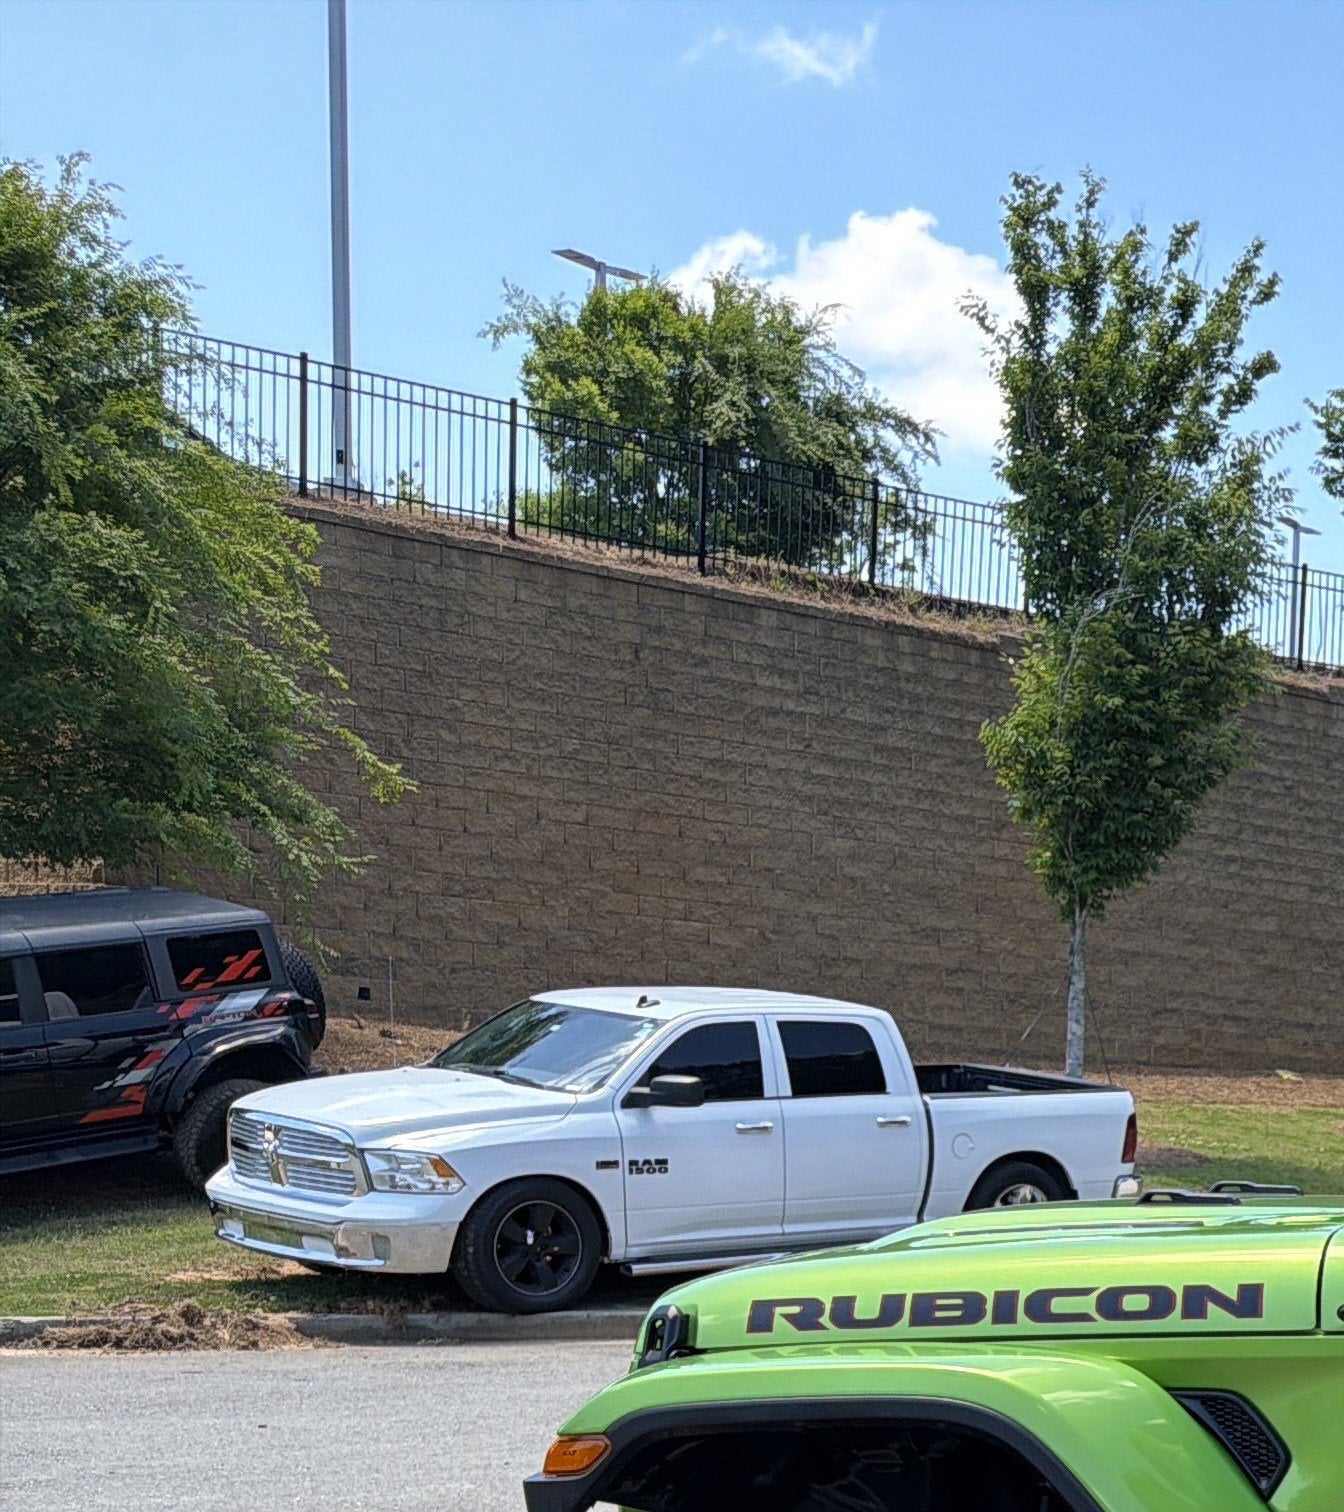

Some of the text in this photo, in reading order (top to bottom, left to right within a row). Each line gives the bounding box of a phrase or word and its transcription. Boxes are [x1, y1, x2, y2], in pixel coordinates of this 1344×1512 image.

[628, 1158, 668, 1167] RAM
[628, 1166, 668, 1175] 1500
[746, 1282, 1264, 1333] RUBICON
